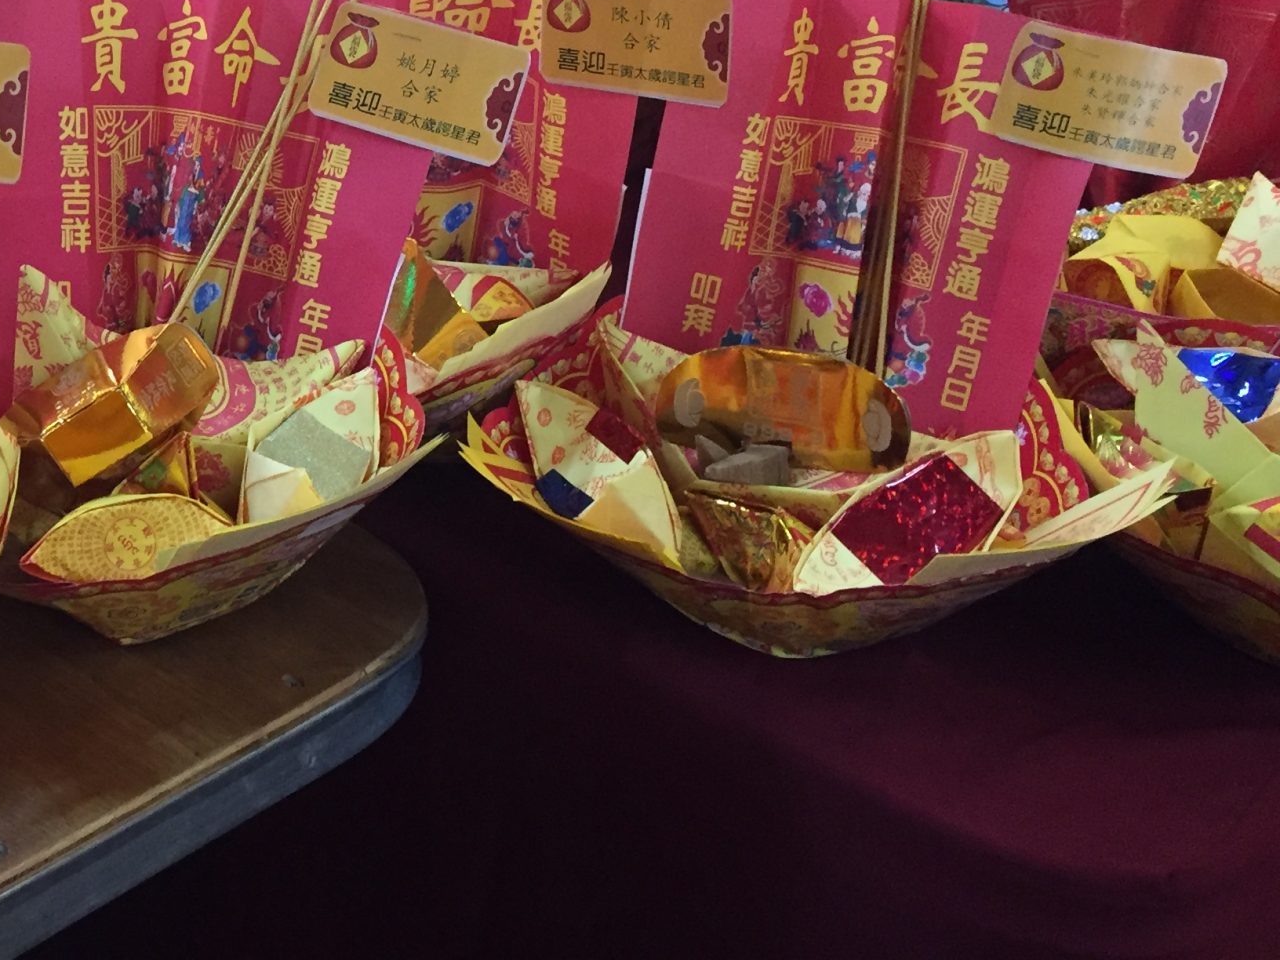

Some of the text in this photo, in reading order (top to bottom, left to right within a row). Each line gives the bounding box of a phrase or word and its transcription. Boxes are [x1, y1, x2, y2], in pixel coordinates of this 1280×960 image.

[58, 105, 92, 254] 如意吉祥
[293, 141, 352, 289] 鴻運亨通
[535, 88, 568, 220] 鴻運亨通
[721, 112, 768, 253] 如意吉祥
[942, 153, 1011, 302] 鴻運亨通
[940, 311, 991, 412] 年月日
